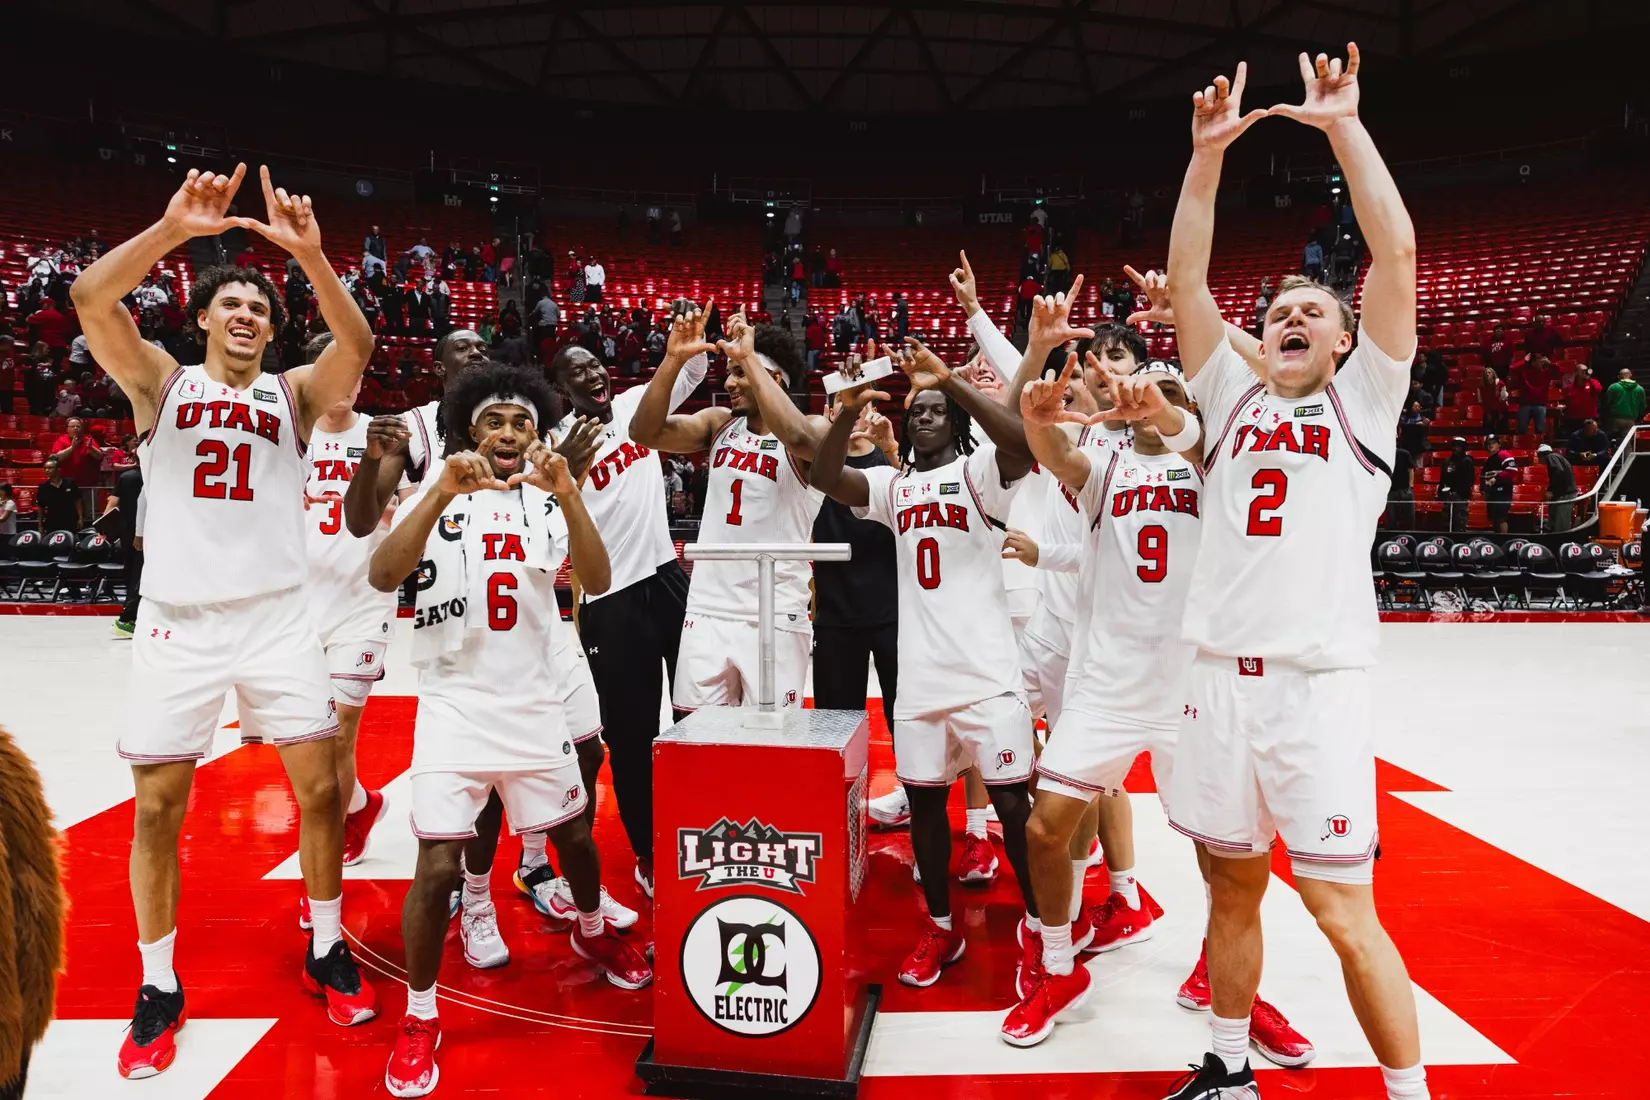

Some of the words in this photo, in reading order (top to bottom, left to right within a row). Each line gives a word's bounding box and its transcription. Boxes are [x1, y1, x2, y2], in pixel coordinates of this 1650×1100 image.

[1, 129, 13, 141] K
[490, 173, 499, 181] 12
[978, 212, 1013, 223] UTAH
[176, 400, 281, 446] UTAH
[1232, 421, 1331, 463] UTAH
[193, 438, 254, 502] 21
[306, 460, 361, 483] TA
[588, 441, 650, 491] UTAH
[712, 446, 778, 483] UTAH
[319, 491, 342, 535] 3
[726, 478, 743, 526] 1
[897, 501, 970, 536] UTAH
[1111, 485, 1200, 519] UTAH
[1246, 468, 1288, 536] 2
[916, 537, 941, 590] 0
[1137, 525, 1168, 583] 9
[413, 597, 467, 630] GATO
[487, 572, 518, 631] 6
[1332, 819, 1347, 834] U
[683, 834, 816, 876] LIGHT
[724, 865, 760, 877] THE
[763, 868, 775, 879] U
[714, 915, 788, 994] DC
[714, 995, 788, 1025] ELECTRIC
